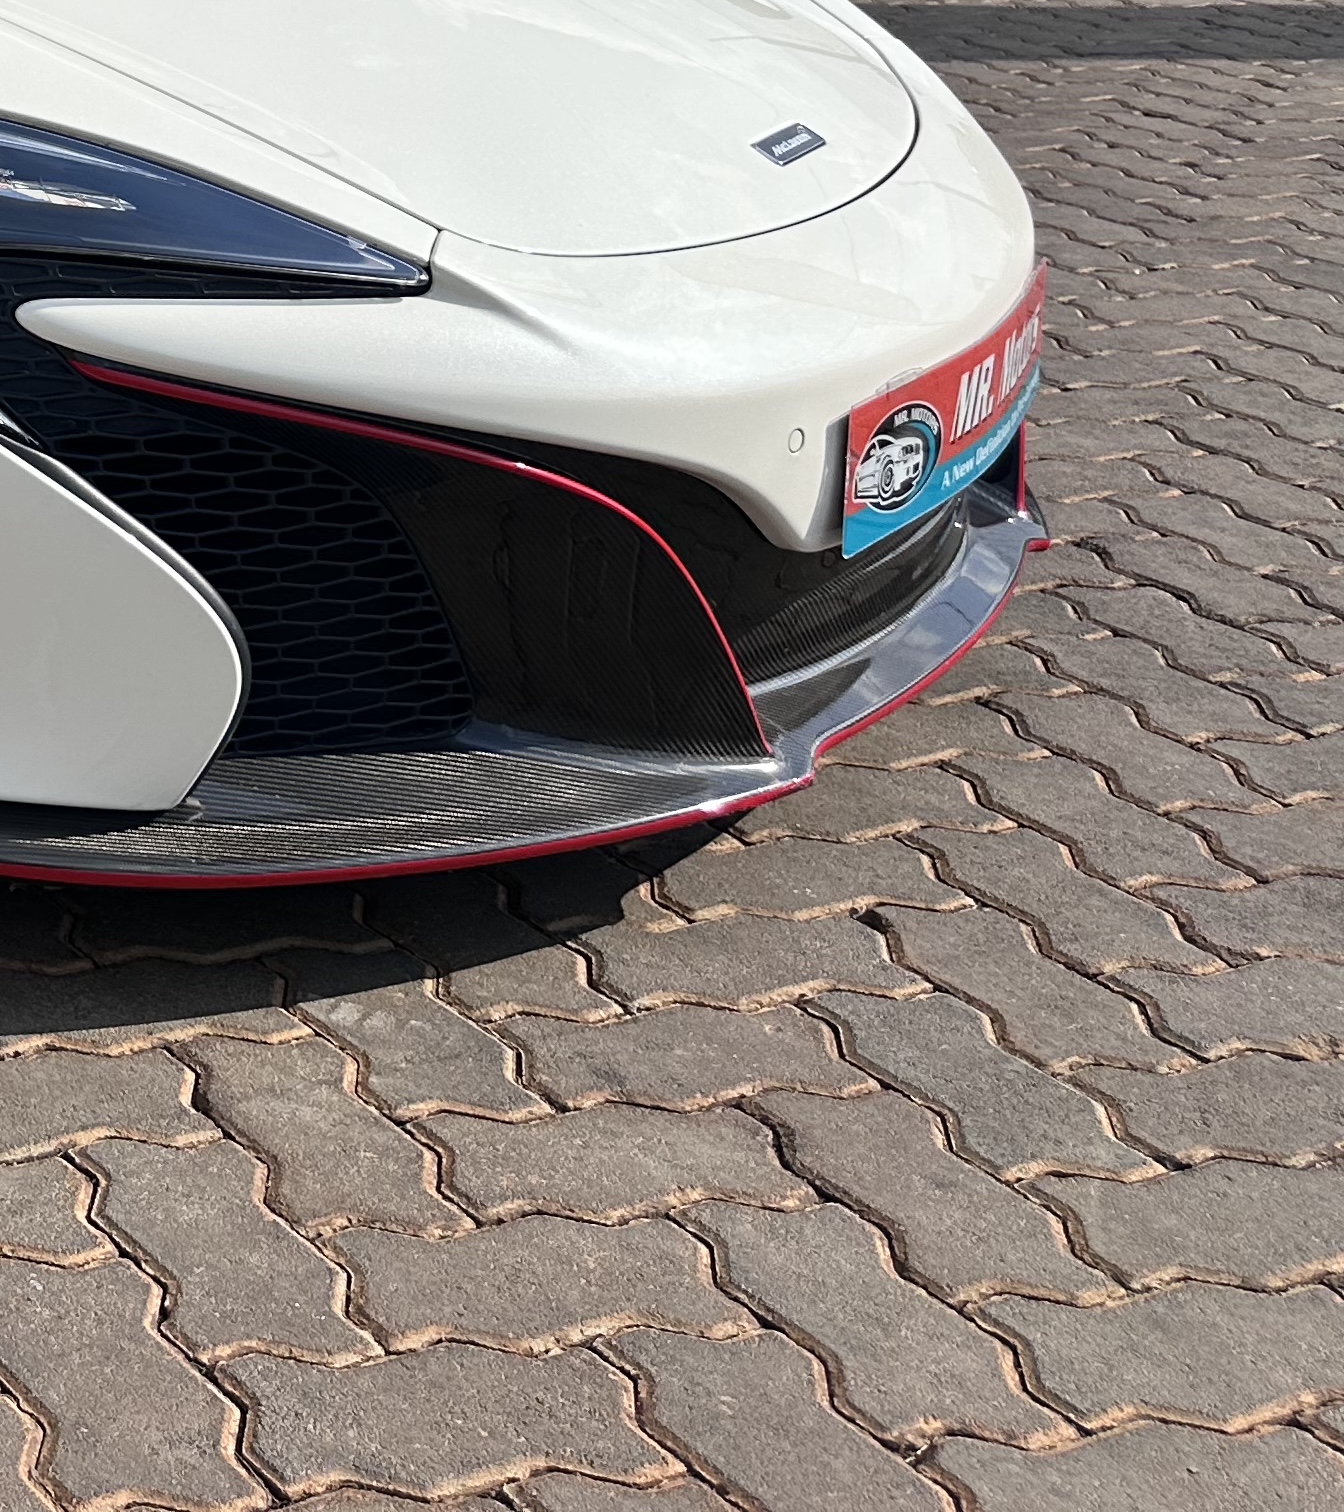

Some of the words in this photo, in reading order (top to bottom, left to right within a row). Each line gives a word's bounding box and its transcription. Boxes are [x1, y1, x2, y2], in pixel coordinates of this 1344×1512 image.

[949, 353, 996, 444] MR.
[909, 407, 940, 436] MOTORS
[940, 470, 952, 491] A
[952, 454, 975, 482] New
